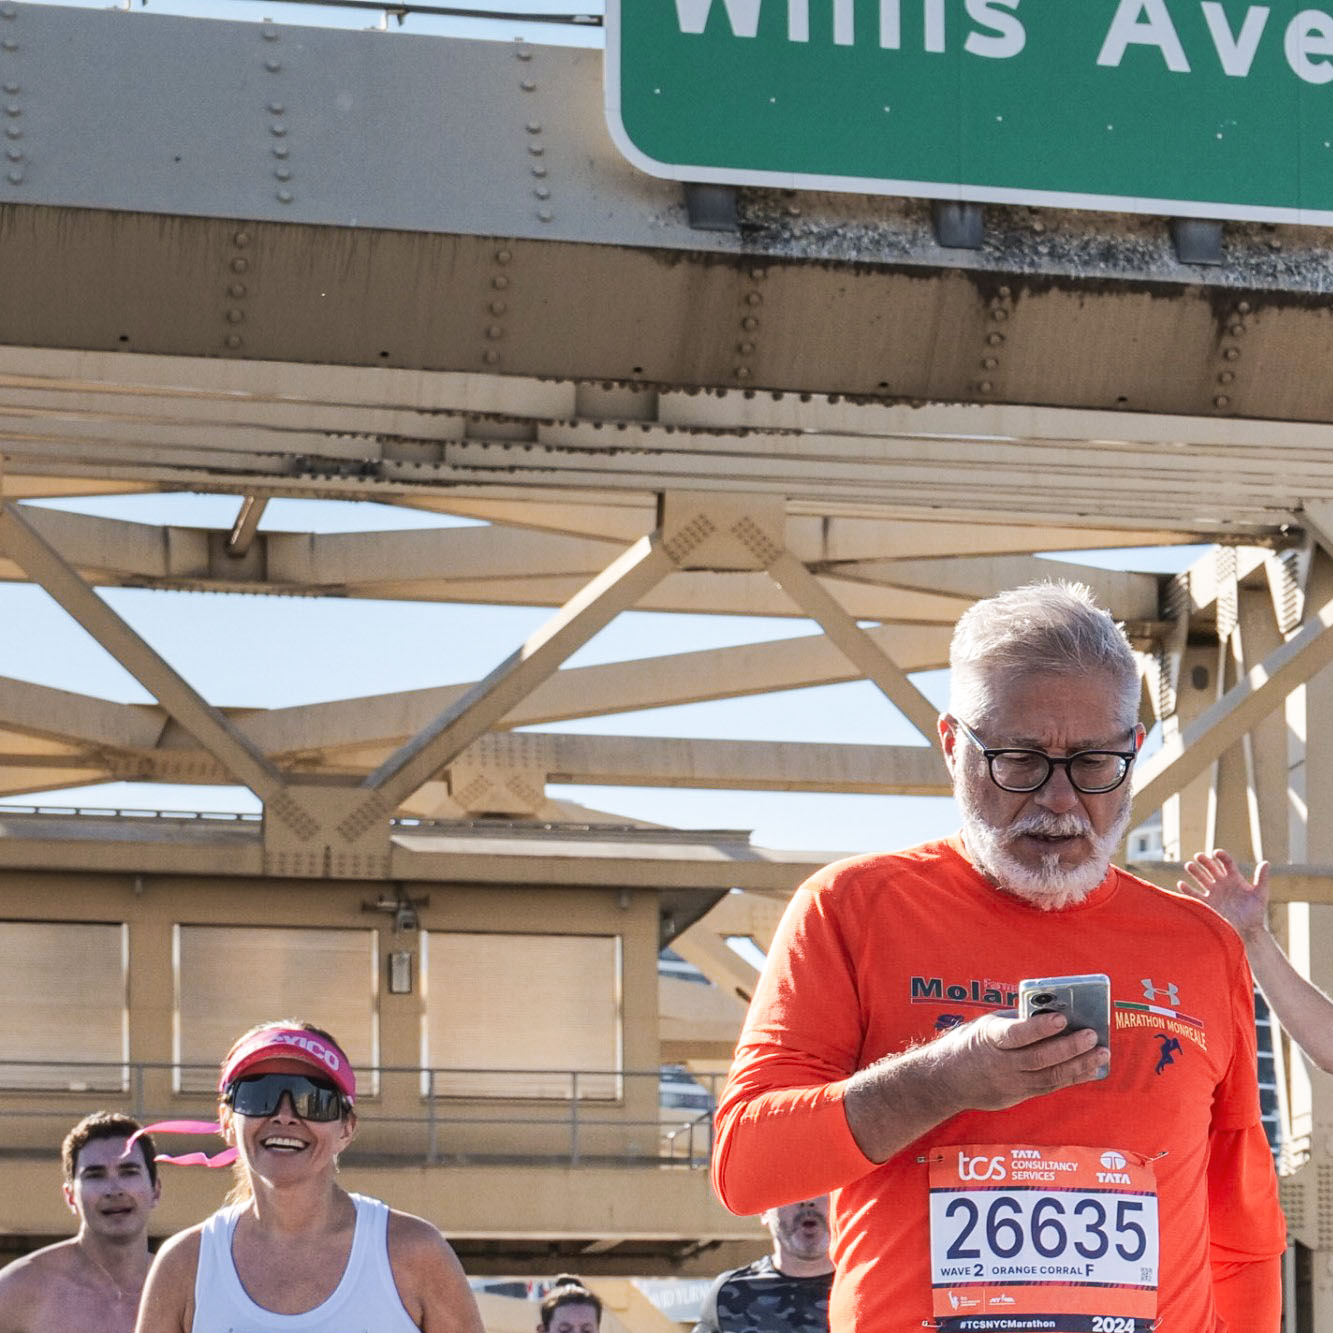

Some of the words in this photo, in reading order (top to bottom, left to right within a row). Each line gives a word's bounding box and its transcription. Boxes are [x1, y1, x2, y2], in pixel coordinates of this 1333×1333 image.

[910, 975, 1019, 1007] Molar
[1115, 1011, 1165, 1030] MARATHON
[1166, 1019, 1207, 1051] MONREALE
[1010, 1149, 1041, 1159] TATA
[958, 1151, 1007, 1181] tcs
[1011, 1160, 1079, 1172] CONSULTANCY
[1011, 1171, 1055, 1181] SERVICES
[1096, 1172, 1131, 1184] TATA
[945, 1196, 1147, 1262] 26635
[940, 1266, 971, 1277] WAVE
[973, 1263, 985, 1277] 2
[991, 1265, 1037, 1275] ORANGE
[1039, 1265, 1083, 1275] CORRAL
[1085, 1263, 1095, 1277] F
[959, 1319, 1056, 1330] #TCSNYCMarathon
[1091, 1316, 1136, 1333] 2024
